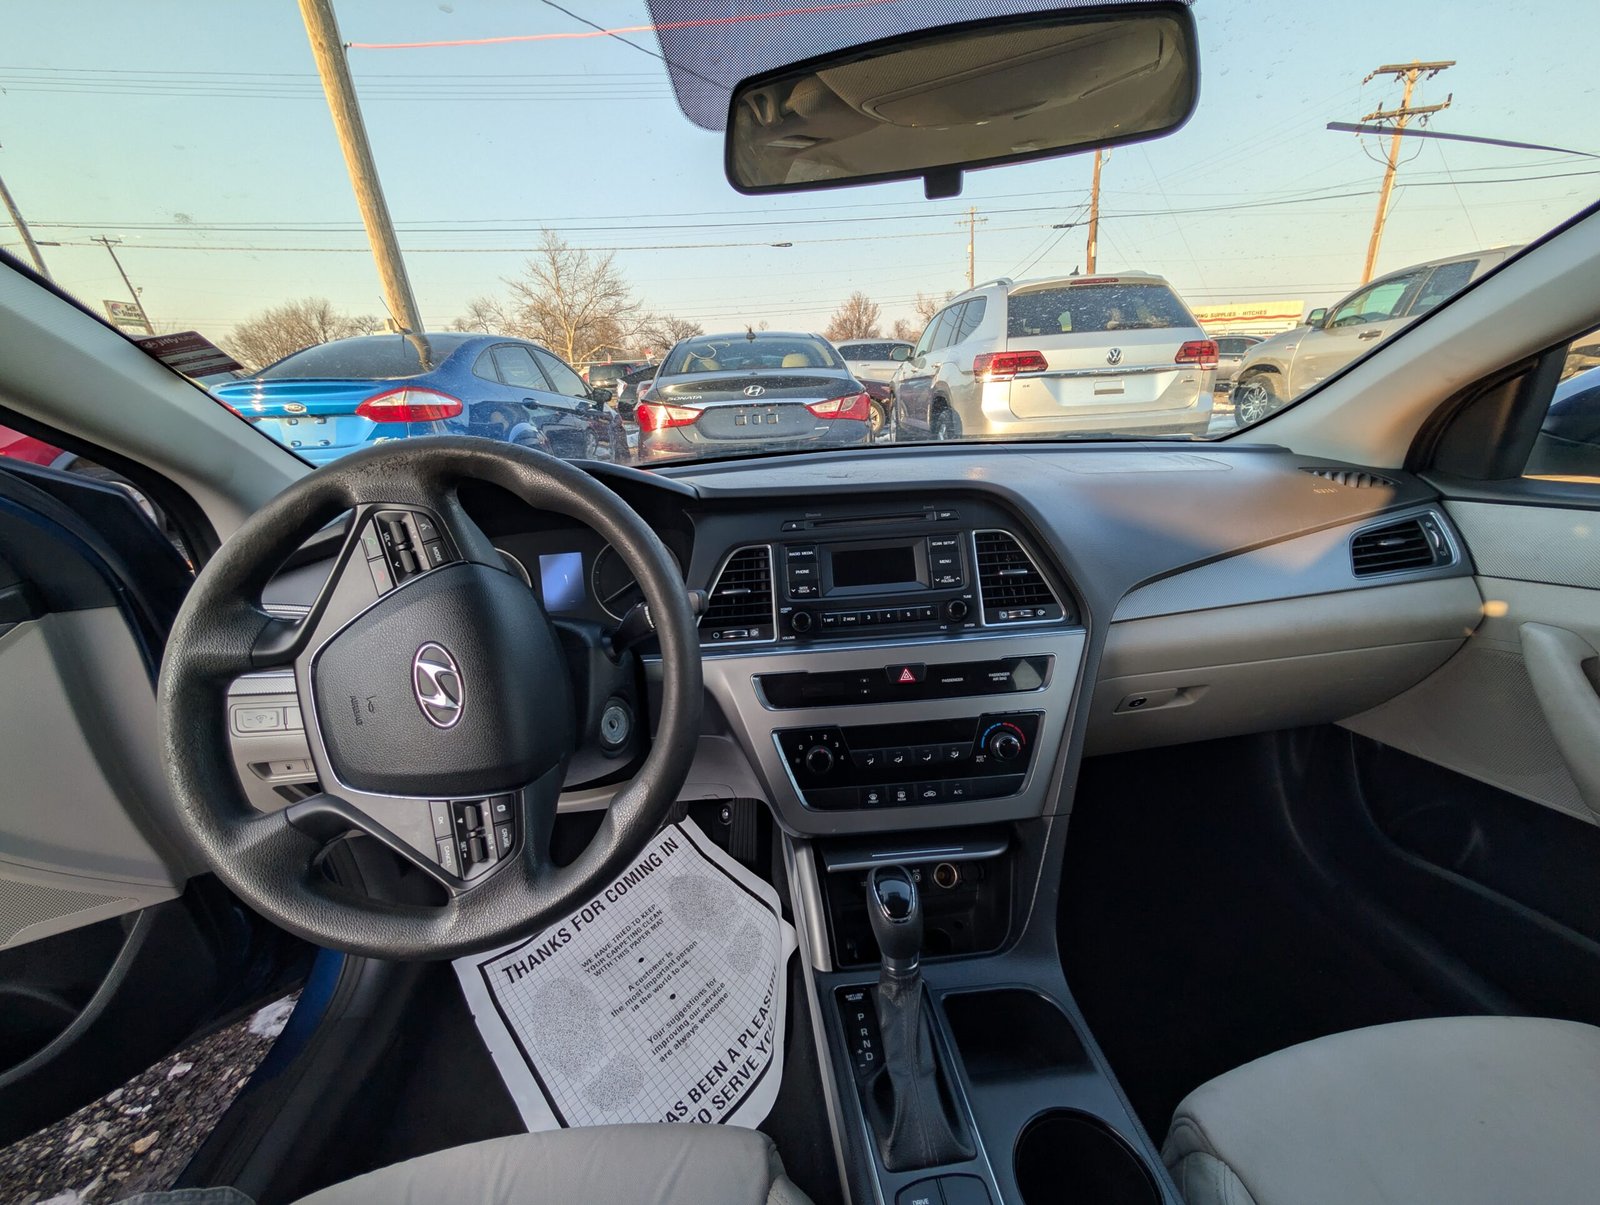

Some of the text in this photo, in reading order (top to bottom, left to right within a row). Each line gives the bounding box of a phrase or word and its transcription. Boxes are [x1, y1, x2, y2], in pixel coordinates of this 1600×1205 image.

[438, 816, 444, 824] OK
[502, 828, 510, 848] CRUISE
[502, 837, 679, 984] THANKS FOR COMING IN
[582, 904, 656, 968] WE HAVE TRIED TO KEEP
[585, 910, 663, 974] YOUR CARPETING CLEAN
[593, 918, 664, 977] WITH THIS PAPER MAT
[611, 940, 698, 1018] the most important person
[631, 1003, 640, 1012] in
[640, 992, 652, 1005] the
[652, 974, 672, 994] world
[672, 967, 680, 976] to
[635, 958, 666, 986] customer
[647, 978, 717, 1044] Your suggestions for
[651, 982, 725, 1055] improving our service
[861, 1028, 868, 1036] R
[660, 1049, 673, 1062] are
[673, 1023, 699, 1050] always
[690, 1017, 774, 1124] O SERVE YOU
[863, 1040, 871, 1048] N
[866, 1052, 873, 1060] D
[659, 1100, 688, 1123] AS
[688, 1060, 728, 1104] BEEN
[727, 1048, 741, 1064] A
